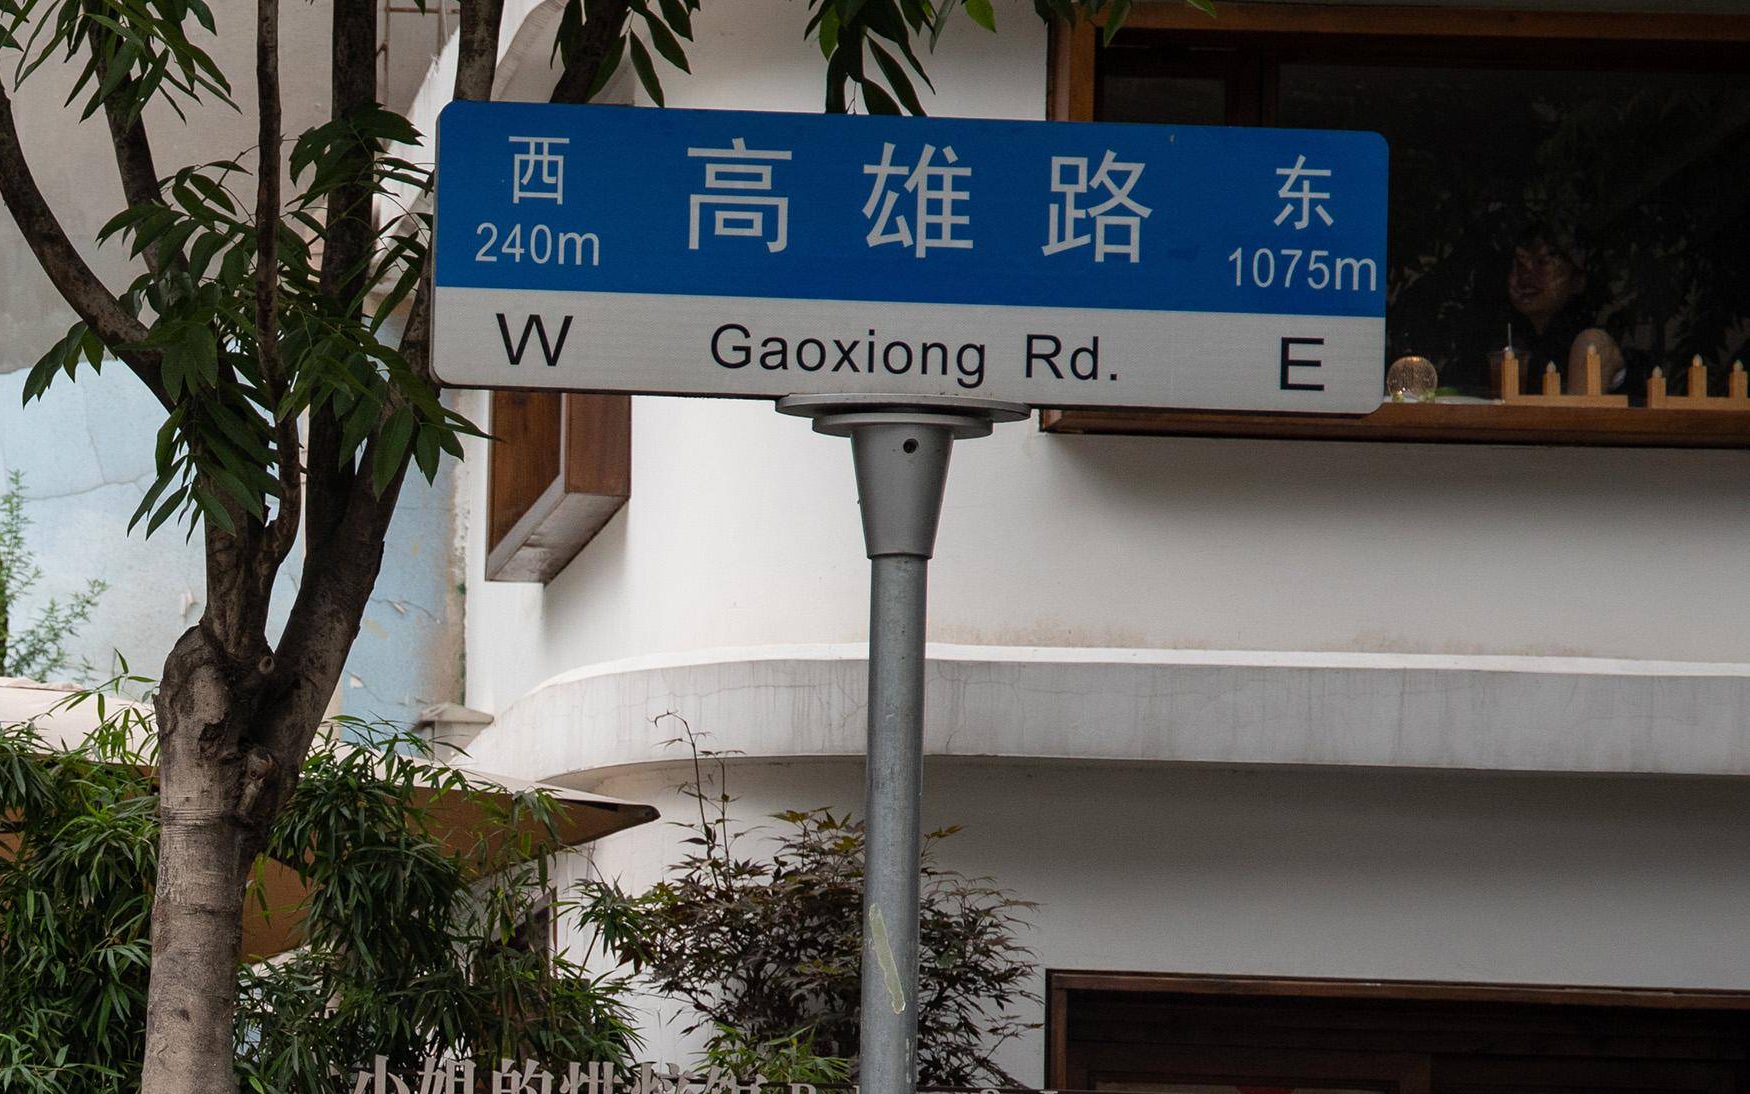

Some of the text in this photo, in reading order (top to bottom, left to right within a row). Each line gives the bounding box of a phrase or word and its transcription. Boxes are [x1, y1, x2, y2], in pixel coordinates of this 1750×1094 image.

[509, 136, 569, 205] 西
[687, 138, 1152, 263] 高雄路
[1274, 155, 1334, 230] 东
[475, 222, 600, 267] 240m
[1227, 248, 1377, 292] 1075m
[495, 312, 574, 367] W
[710, 323, 1118, 388] Gaoxiong Rd.
[1279, 336, 1325, 392] E
